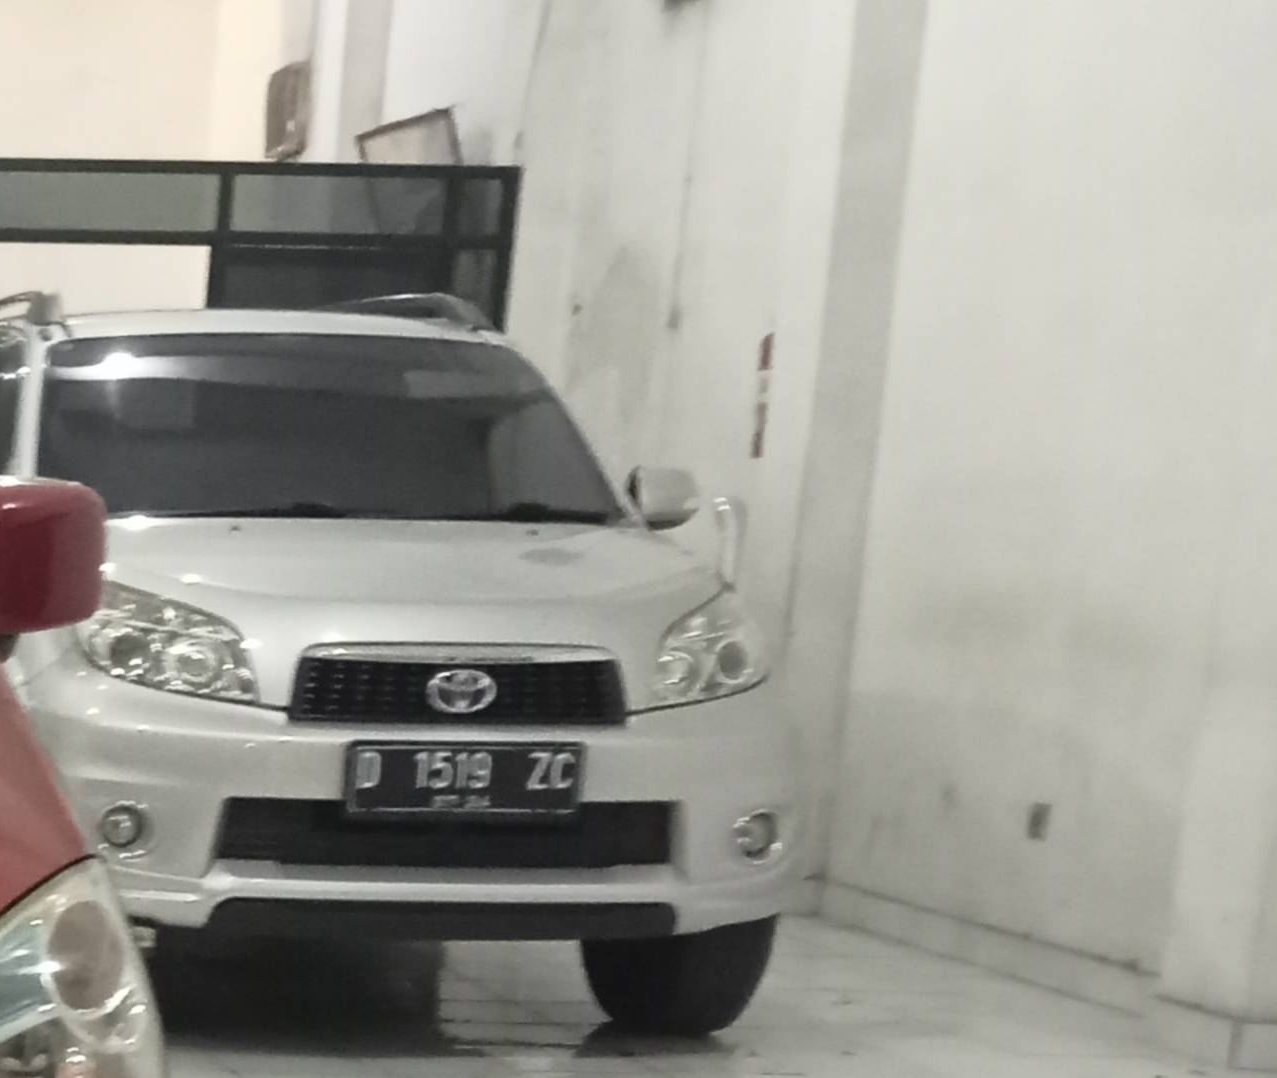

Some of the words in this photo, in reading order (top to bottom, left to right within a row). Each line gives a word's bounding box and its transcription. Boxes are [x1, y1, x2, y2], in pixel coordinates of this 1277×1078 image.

[355, 751, 382, 789] D
[413, 751, 493, 790] 1519
[525, 751, 577, 791] ZC
